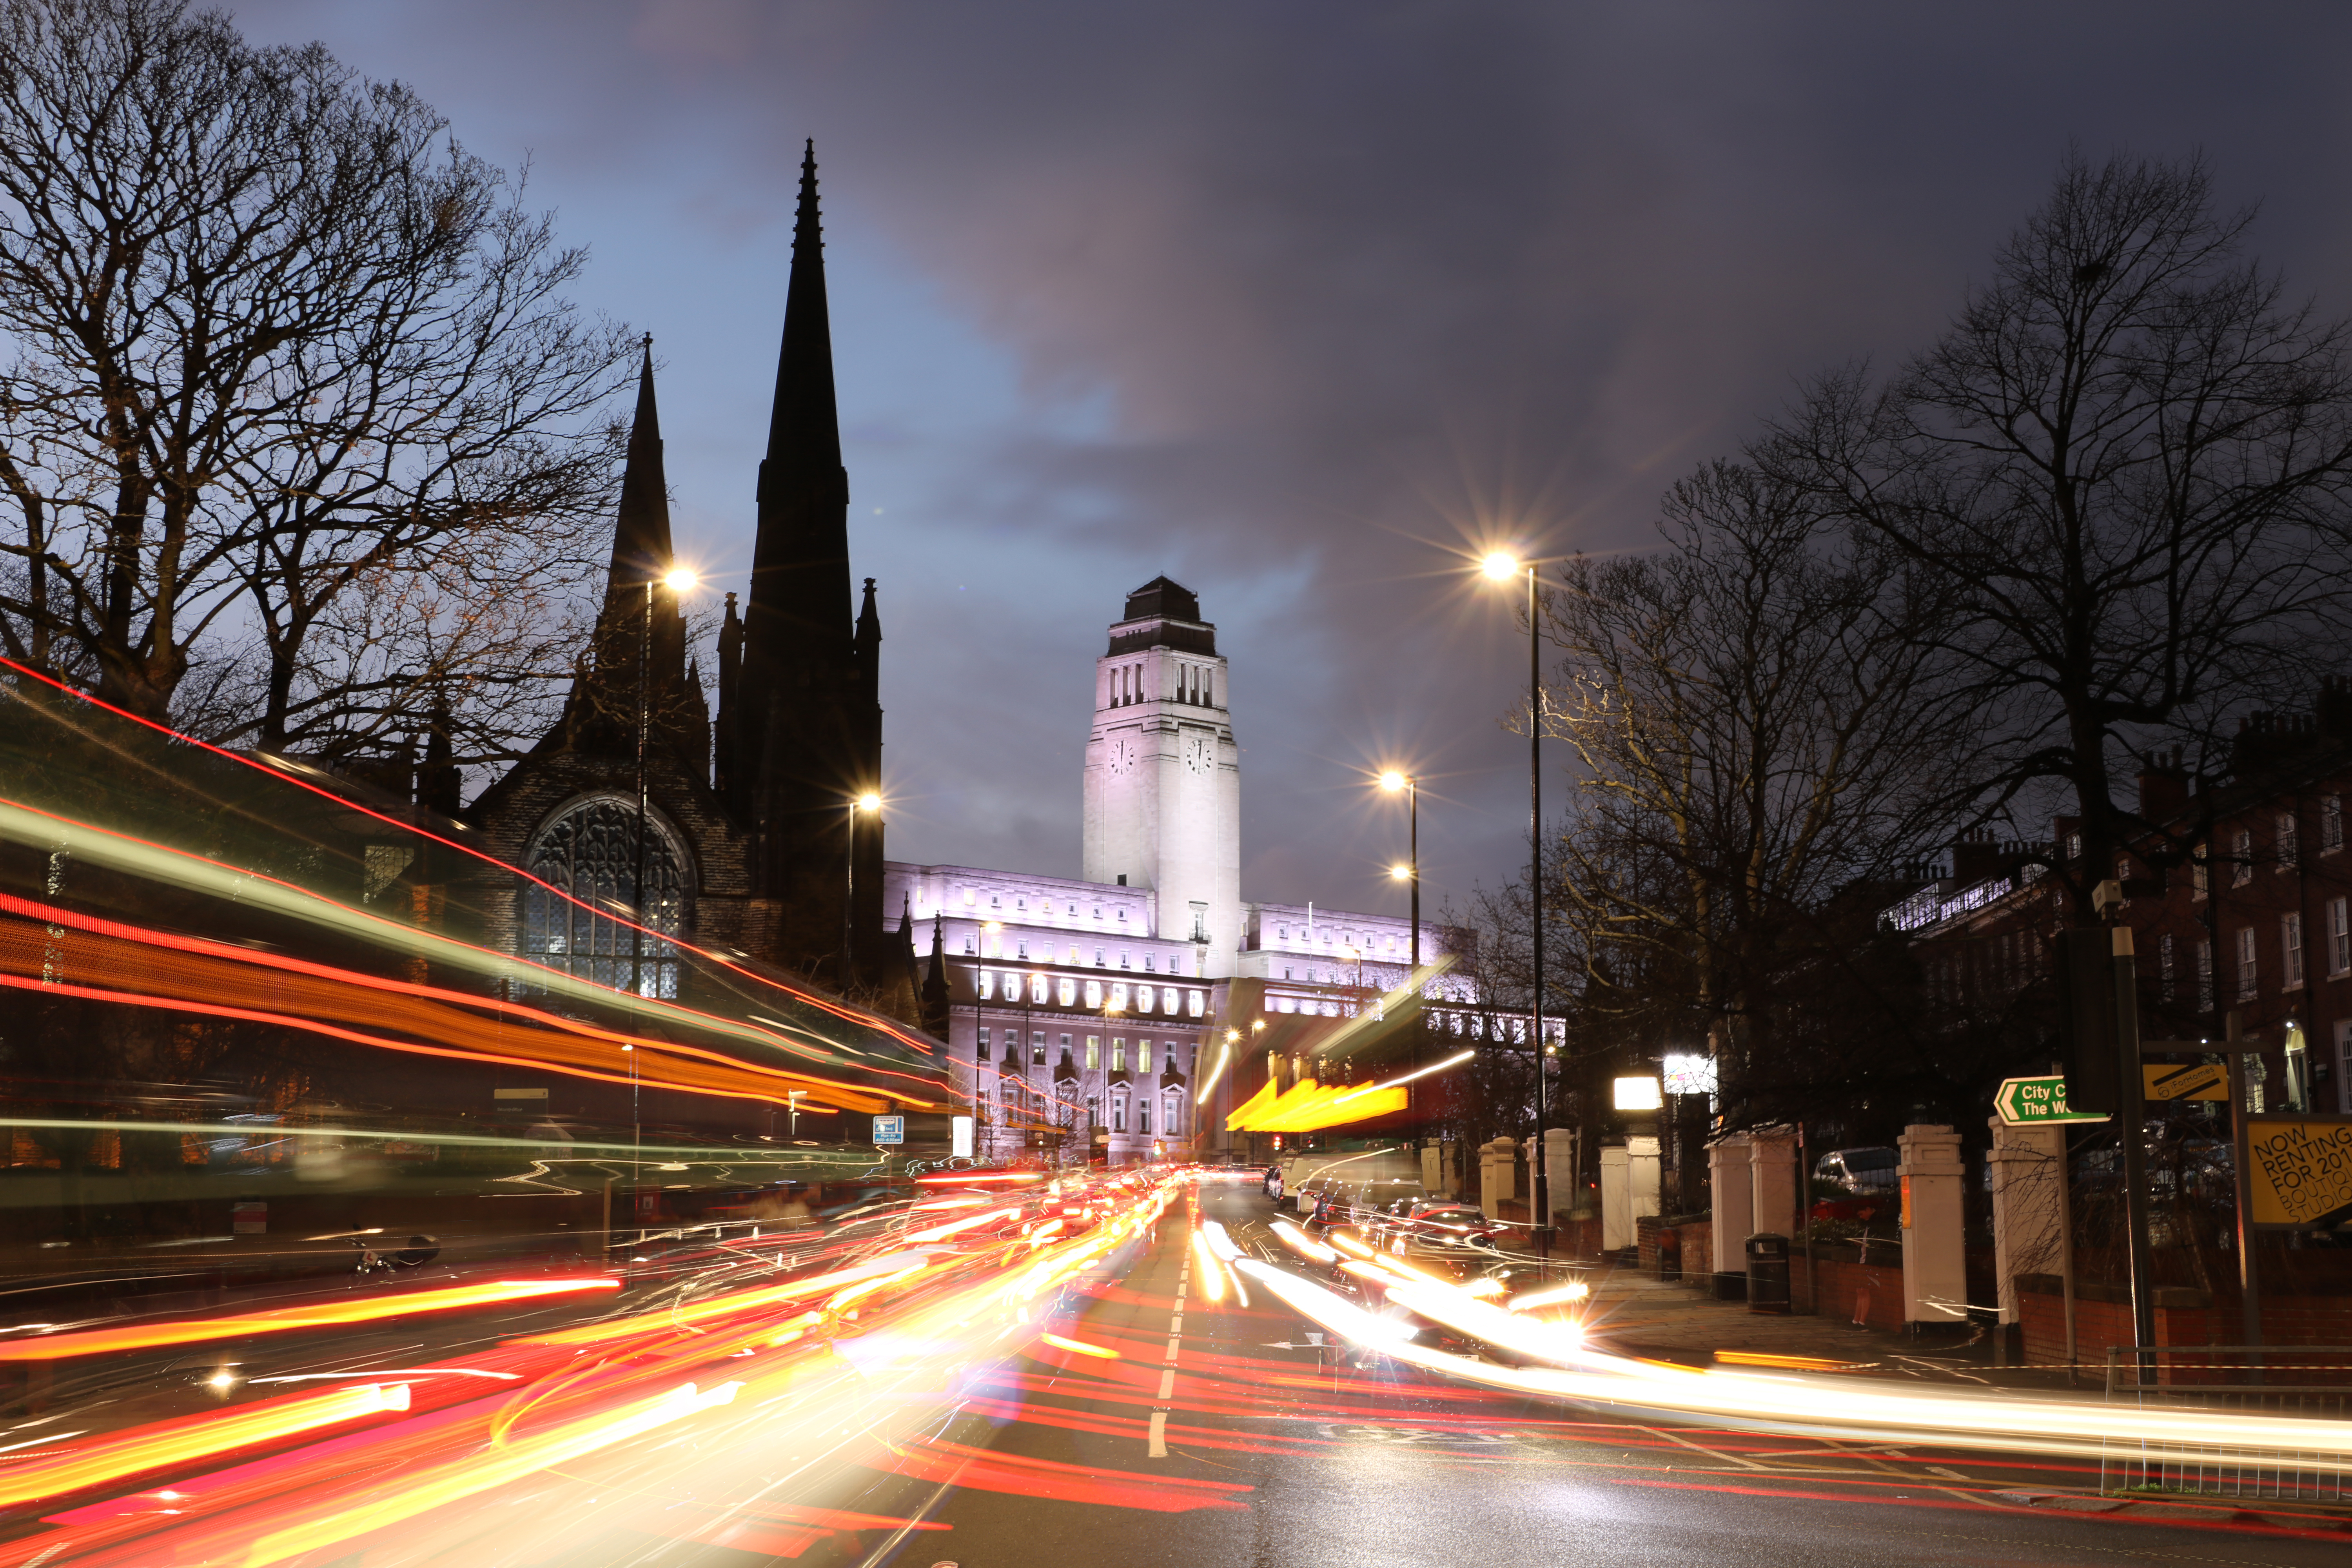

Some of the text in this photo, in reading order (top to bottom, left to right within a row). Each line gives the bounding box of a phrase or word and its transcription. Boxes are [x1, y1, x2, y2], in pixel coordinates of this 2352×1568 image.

[2170, 1067, 2214, 1089] iForHomes
[2022, 1085, 2050, 1101] City
[2022, 1102, 2047, 1115] The
[2253, 1124, 2307, 1161] NOW
[2262, 1127, 2352, 1178] RENTING
[2271, 1144, 2352, 1195] FOR 201
[2289, 1186, 2352, 1223] STUDIO
[367, 1253, 374, 1261] L
